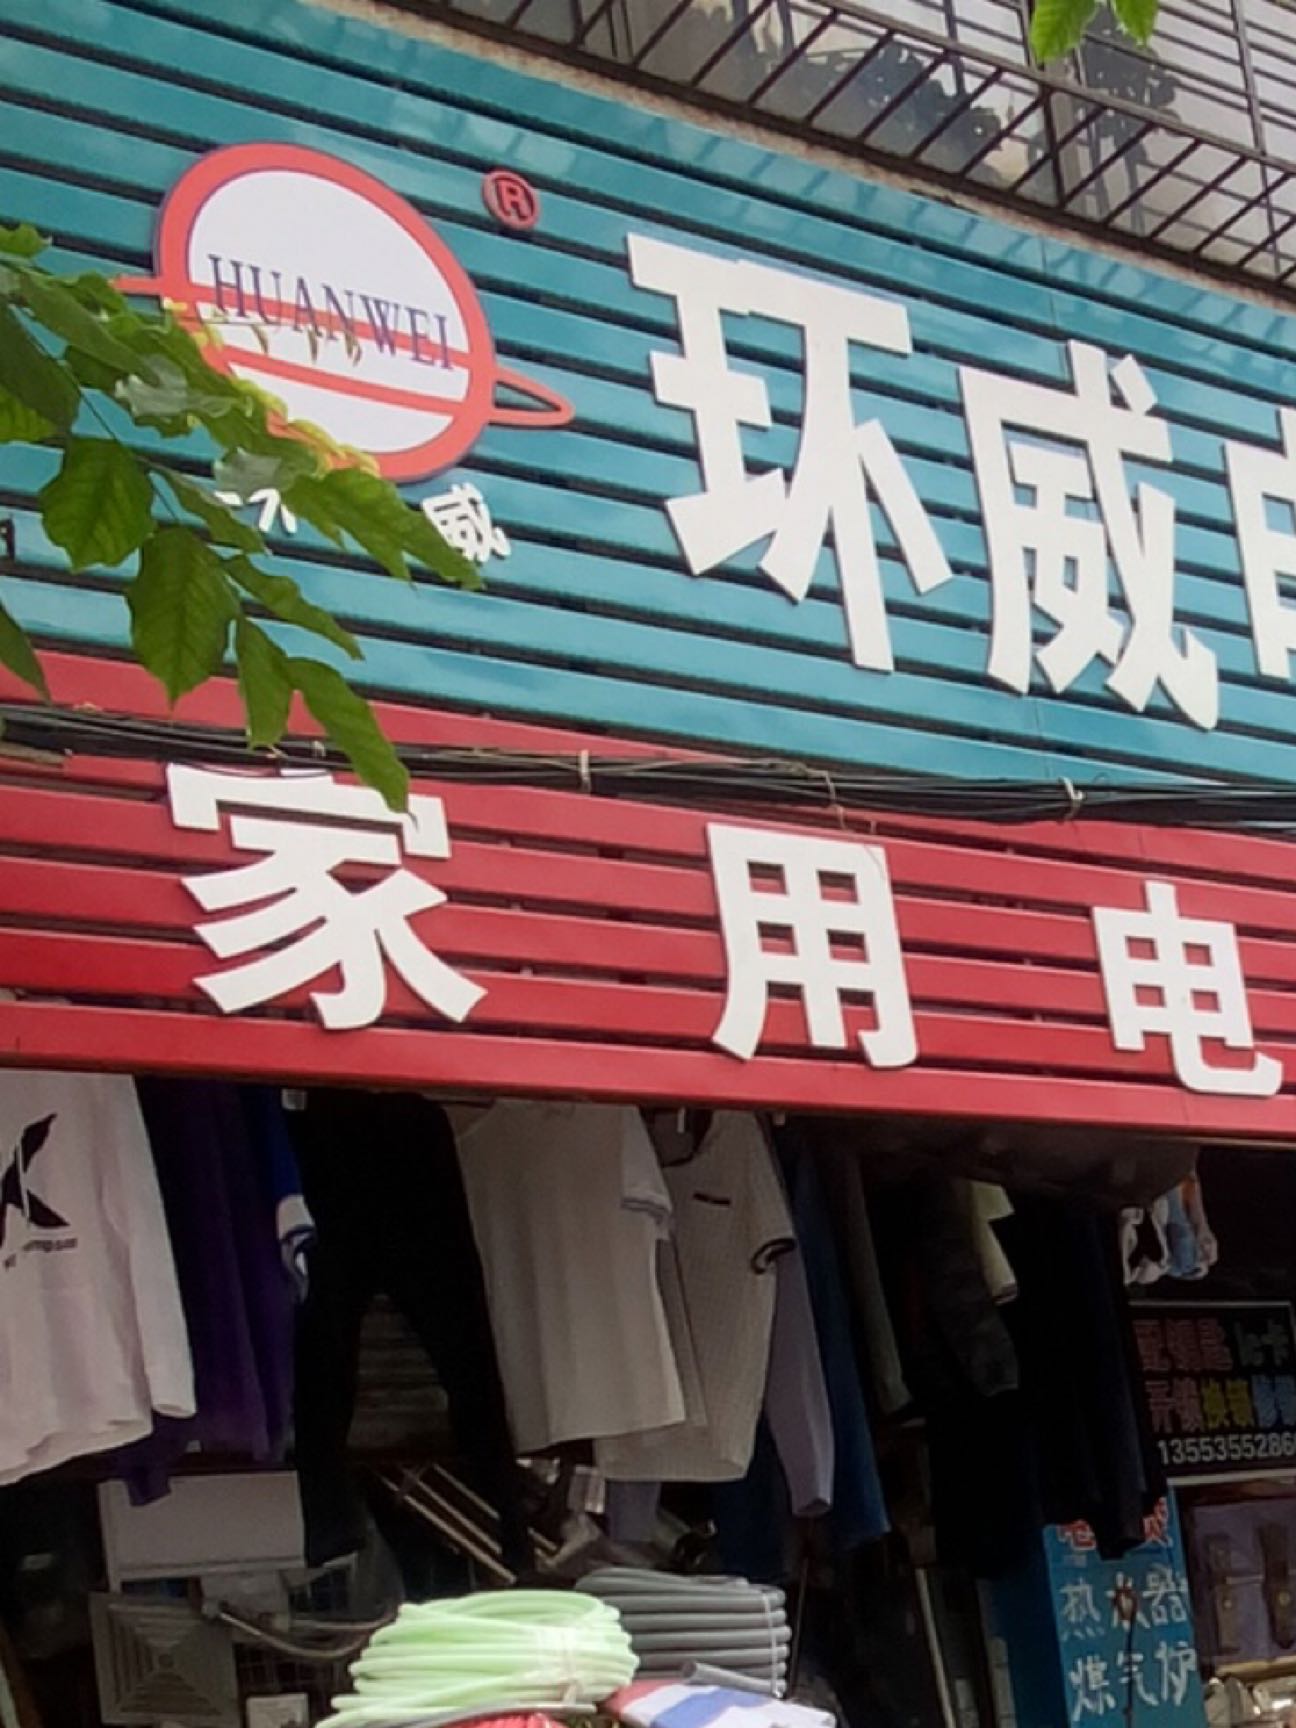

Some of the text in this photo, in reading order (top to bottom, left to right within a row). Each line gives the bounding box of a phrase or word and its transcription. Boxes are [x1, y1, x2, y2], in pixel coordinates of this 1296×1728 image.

[207, 252, 457, 370] HUANWEI
[1059, 1563, 1190, 1642] 热水器
